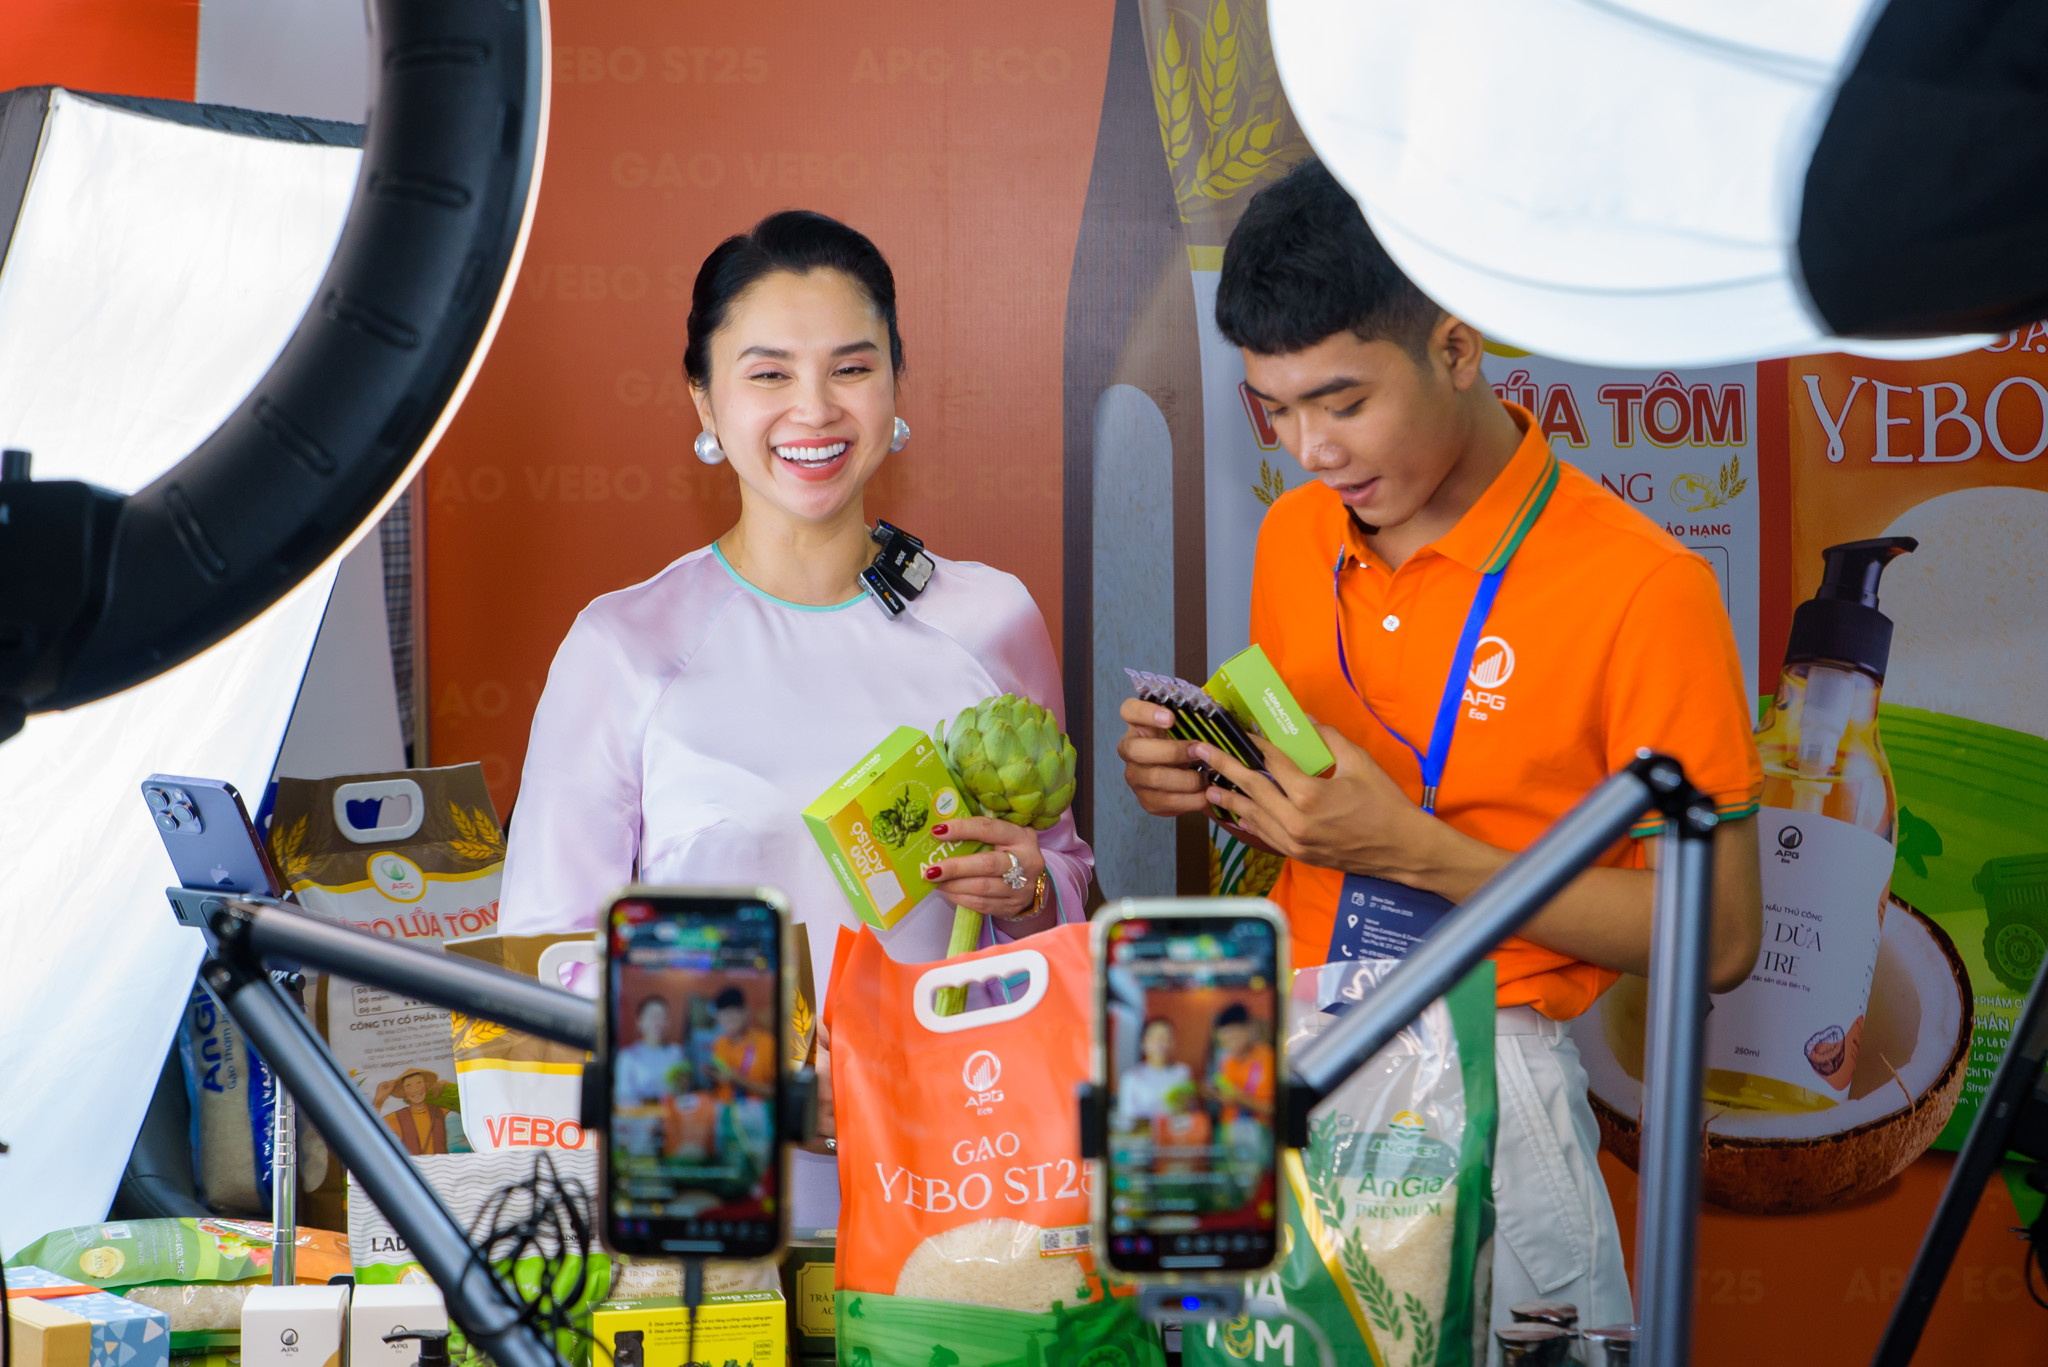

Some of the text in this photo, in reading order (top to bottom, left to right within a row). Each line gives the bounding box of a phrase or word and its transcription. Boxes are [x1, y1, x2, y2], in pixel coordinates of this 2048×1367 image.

[551, 46, 769, 84] EBO ST25
[851, 46, 1072, 85] APG ECO
[743, 152, 867, 189] VEBO
[1598, 371, 1748, 449] TÔM
[523, 465, 650, 502] VEBO
[1689, 523, 1732, 539] HẠNG
[1462, 688, 1507, 711] APG
[1468, 707, 1488, 721] Eco
[1774, 849, 1800, 860] APG
[1800, 909, 1823, 922] CÔNG
[1775, 922, 1822, 952] DỪA
[1762, 950, 1800, 977] TRE
[349, 1020, 380, 1031] CÔNG
[383, 1018, 396, 1027] TY
[1734, 1046, 1760, 1058] 250ml
[1966, 1082, 1992, 1093] Stree
[964, 1090, 1005, 1108] APG
[484, 1114, 588, 1151] VEBO
[1357, 1172, 1445, 1198] AnGia
[1355, 1202, 1442, 1219] PREMIUM
[371, 1237, 408, 1252] LAD
[1842, 1267, 1910, 1304] AP
[810, 1291, 830, 1303] TRÀ
